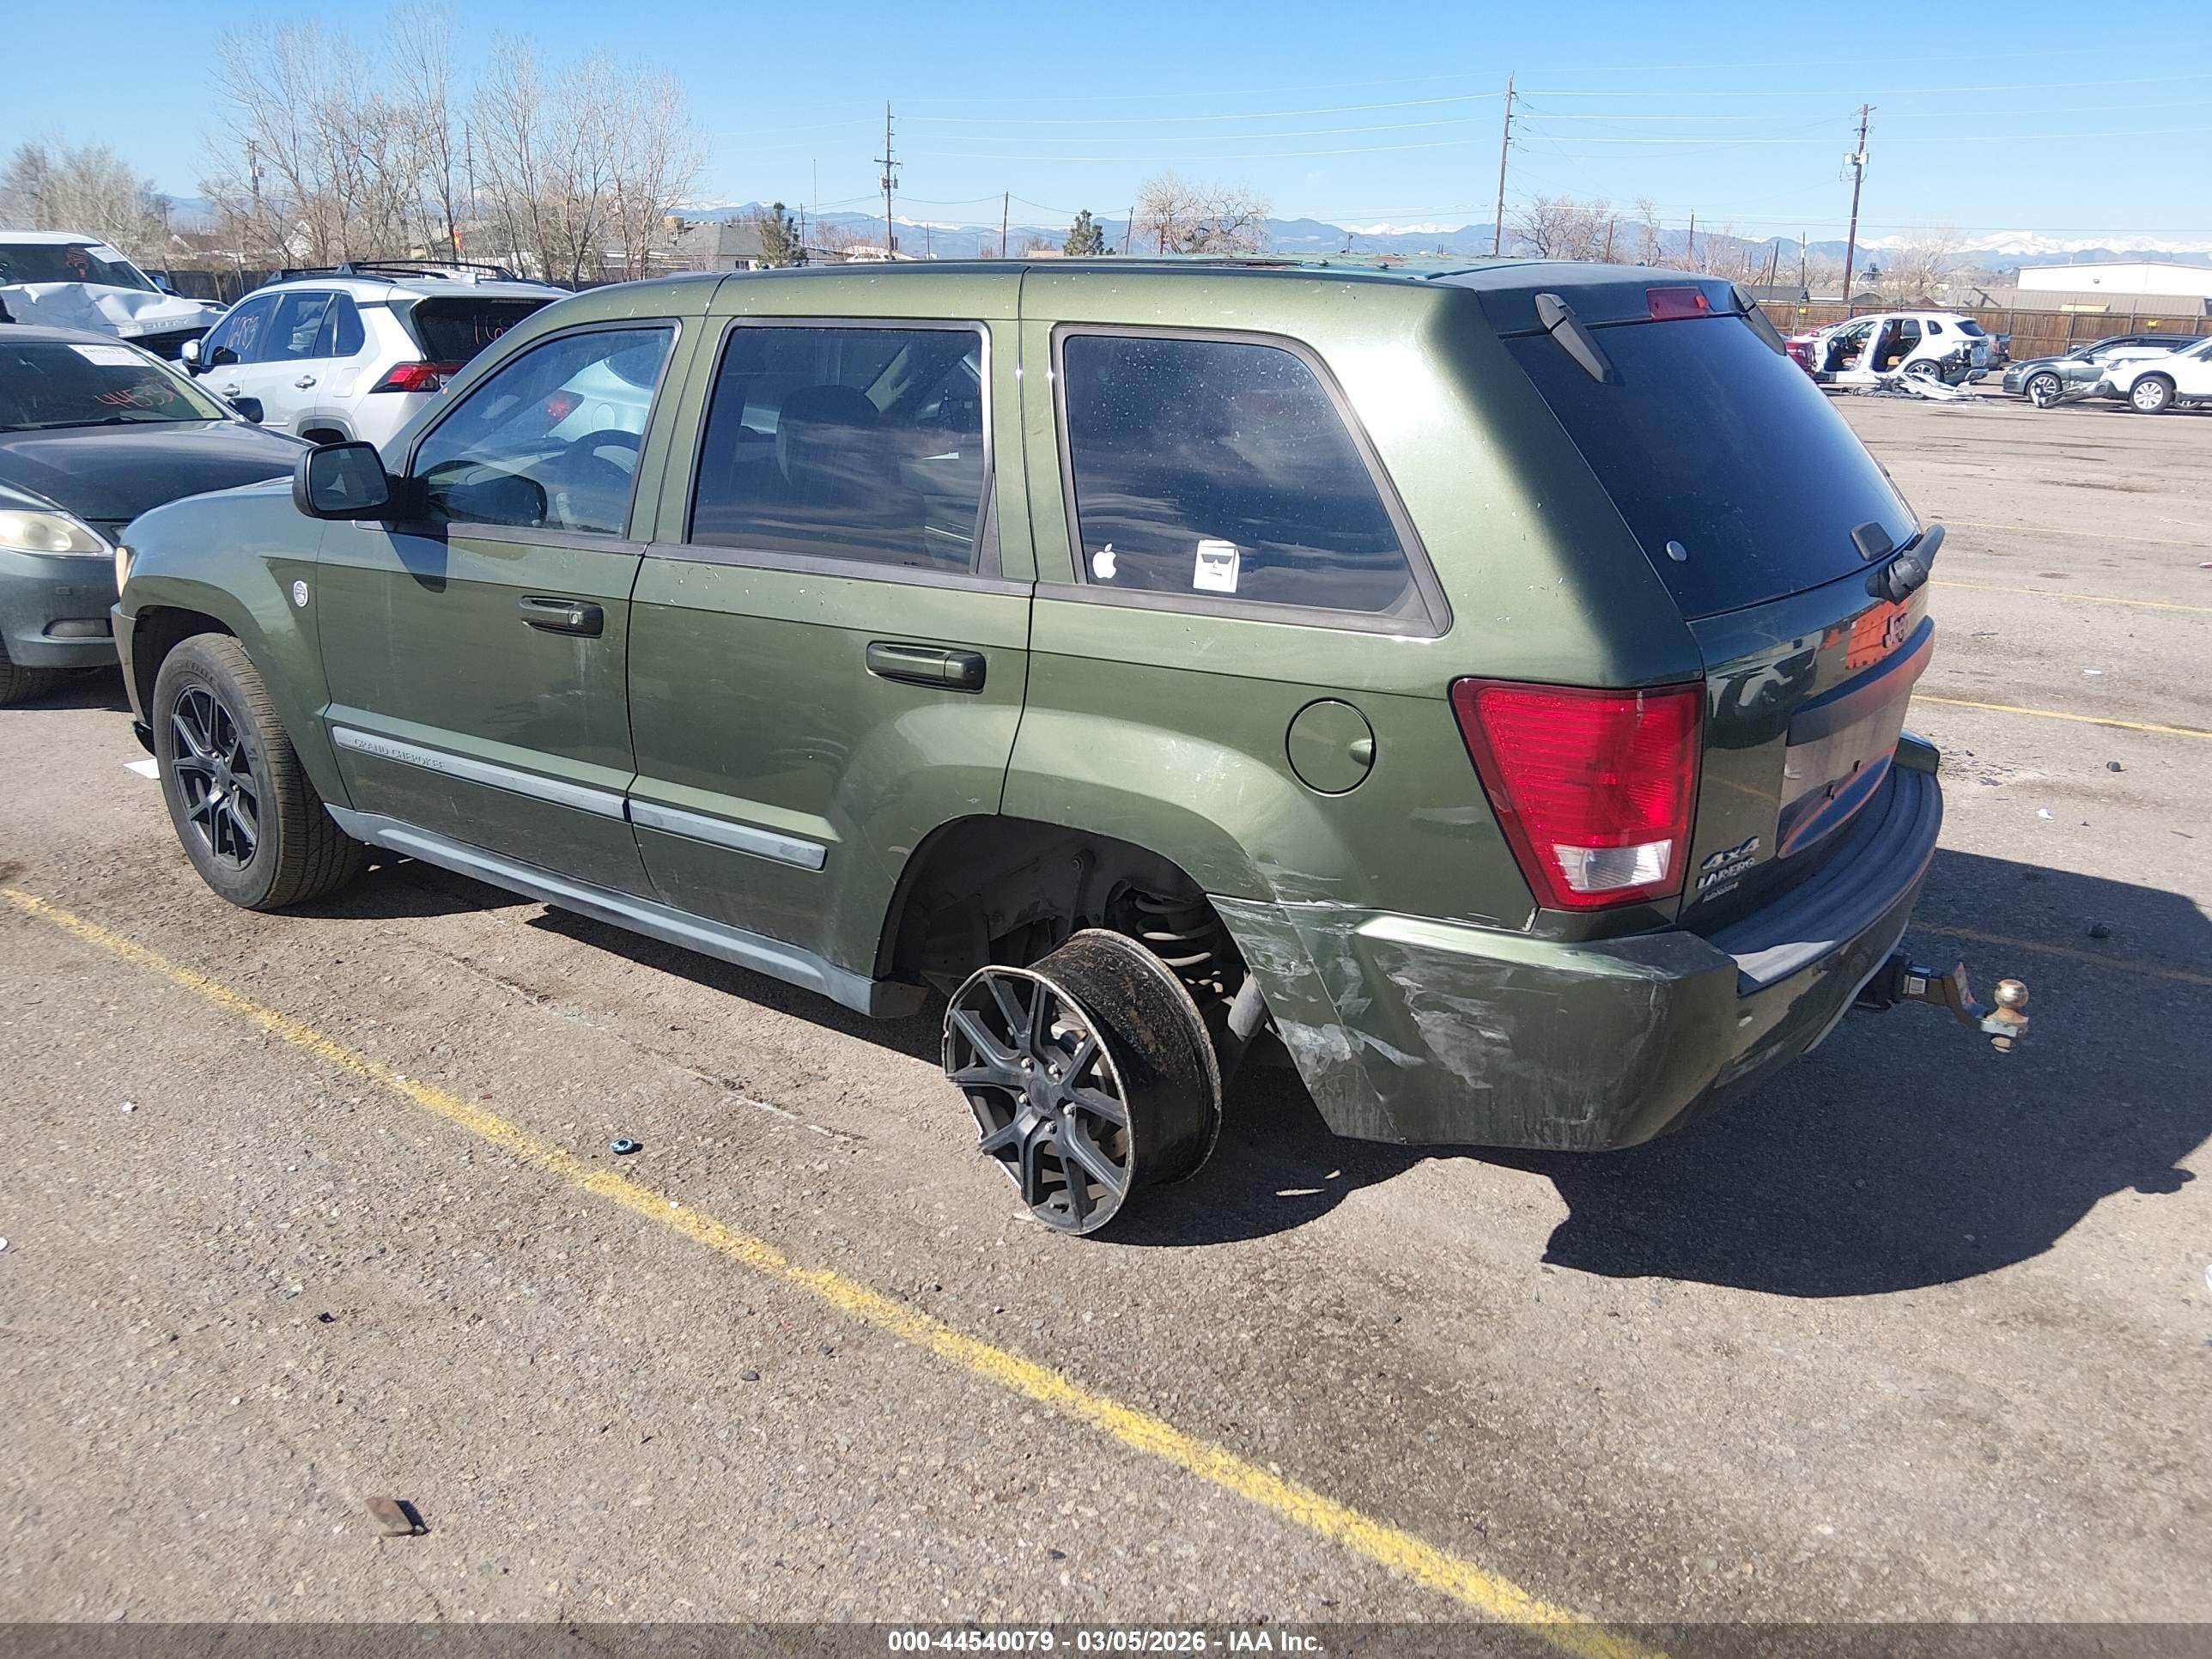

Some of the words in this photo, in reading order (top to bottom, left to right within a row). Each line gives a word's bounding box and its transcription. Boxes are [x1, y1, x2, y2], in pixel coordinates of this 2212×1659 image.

[354, 738, 389, 755] GRAND
[392, 749, 447, 770] CHEROKEE
[1701, 836, 1760, 870] 4x4
